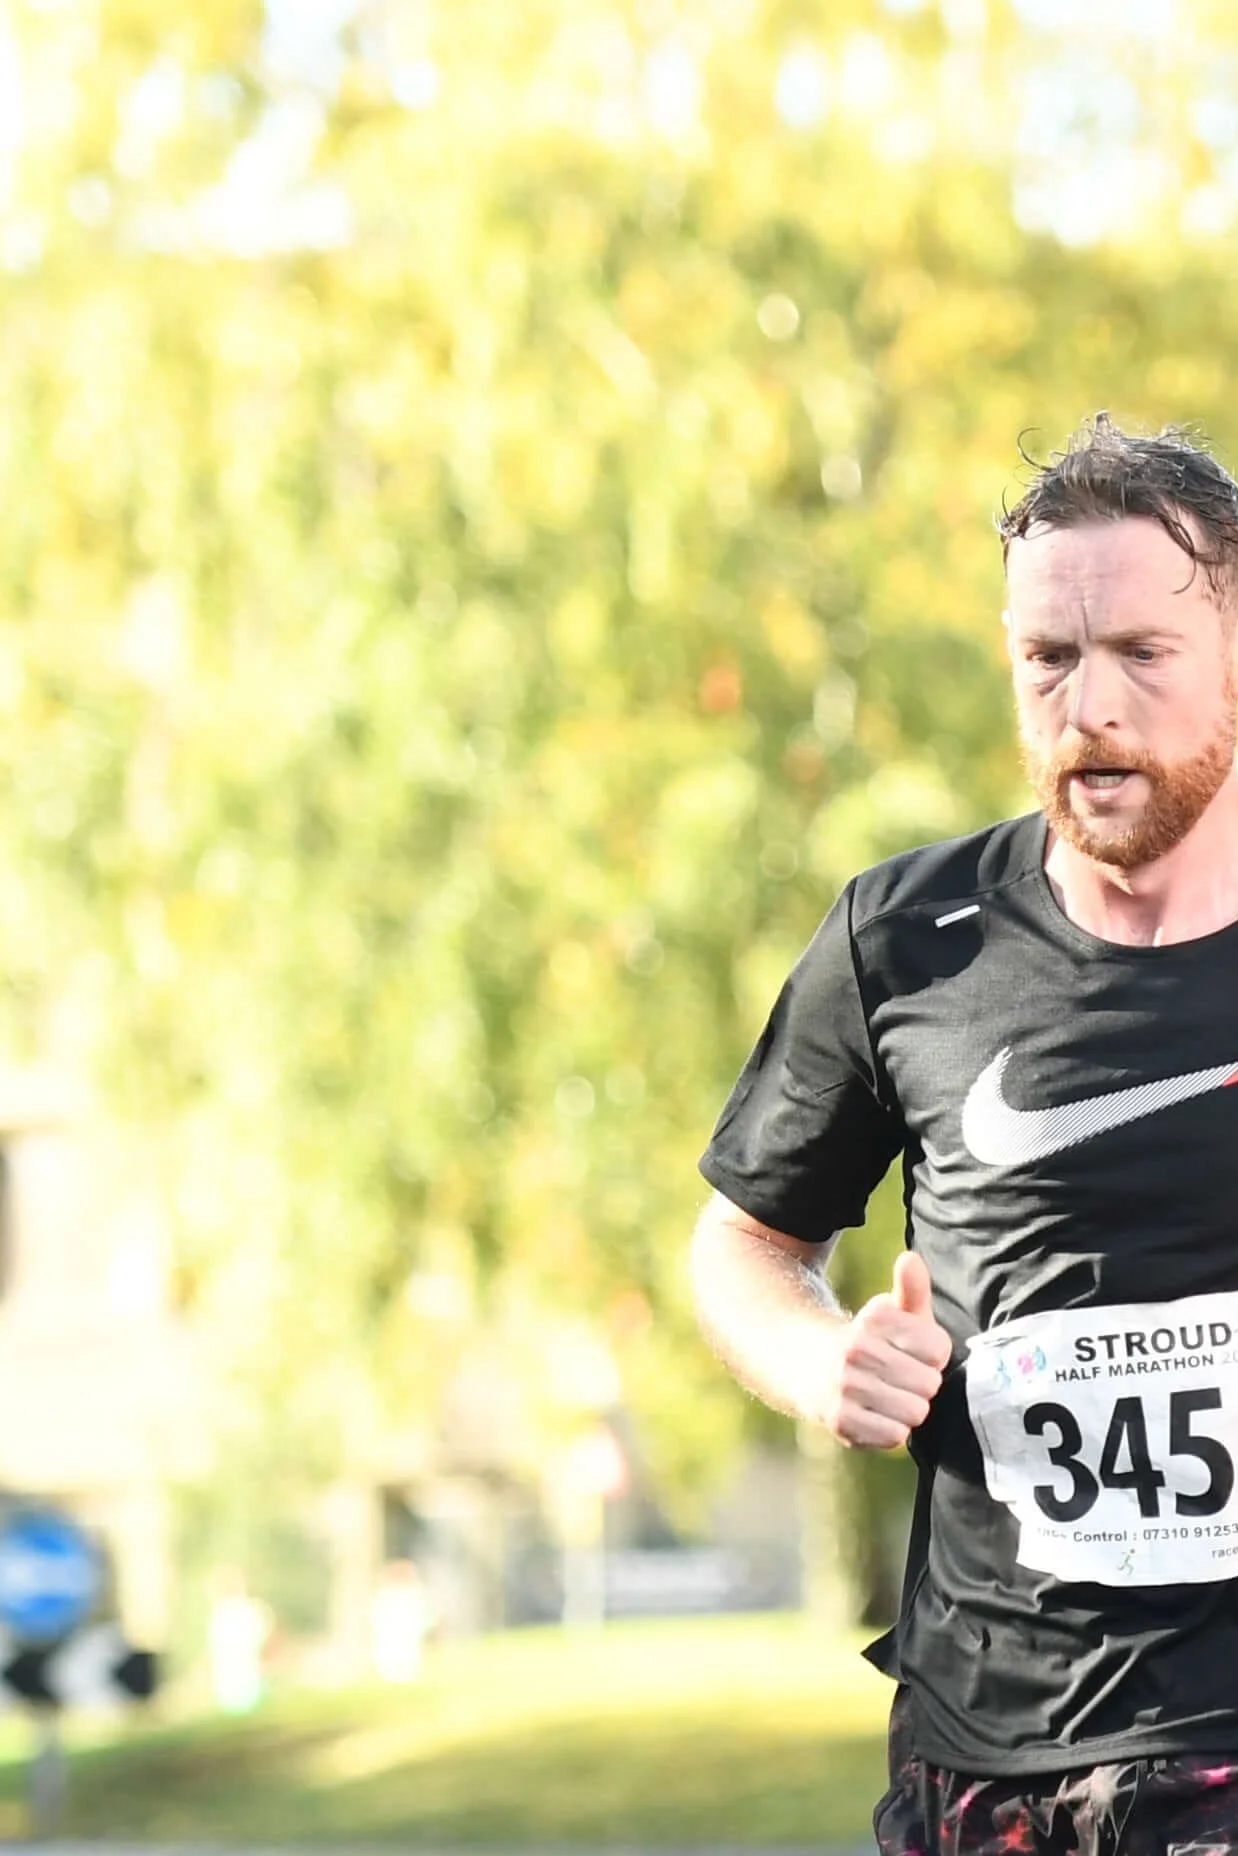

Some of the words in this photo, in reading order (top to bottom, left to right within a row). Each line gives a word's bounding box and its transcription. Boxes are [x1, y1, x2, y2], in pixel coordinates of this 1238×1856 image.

[1074, 1322, 1232, 1362] STROUD
[1055, 1365, 1102, 1382] HALF
[1108, 1353, 1214, 1378] MARATHON
[1023, 1387, 1235, 1522] 345
[1073, 1530, 1127, 1542] Control
[1143, 1527, 1188, 1540] 07310
[1211, 1546, 1238, 1558] race
